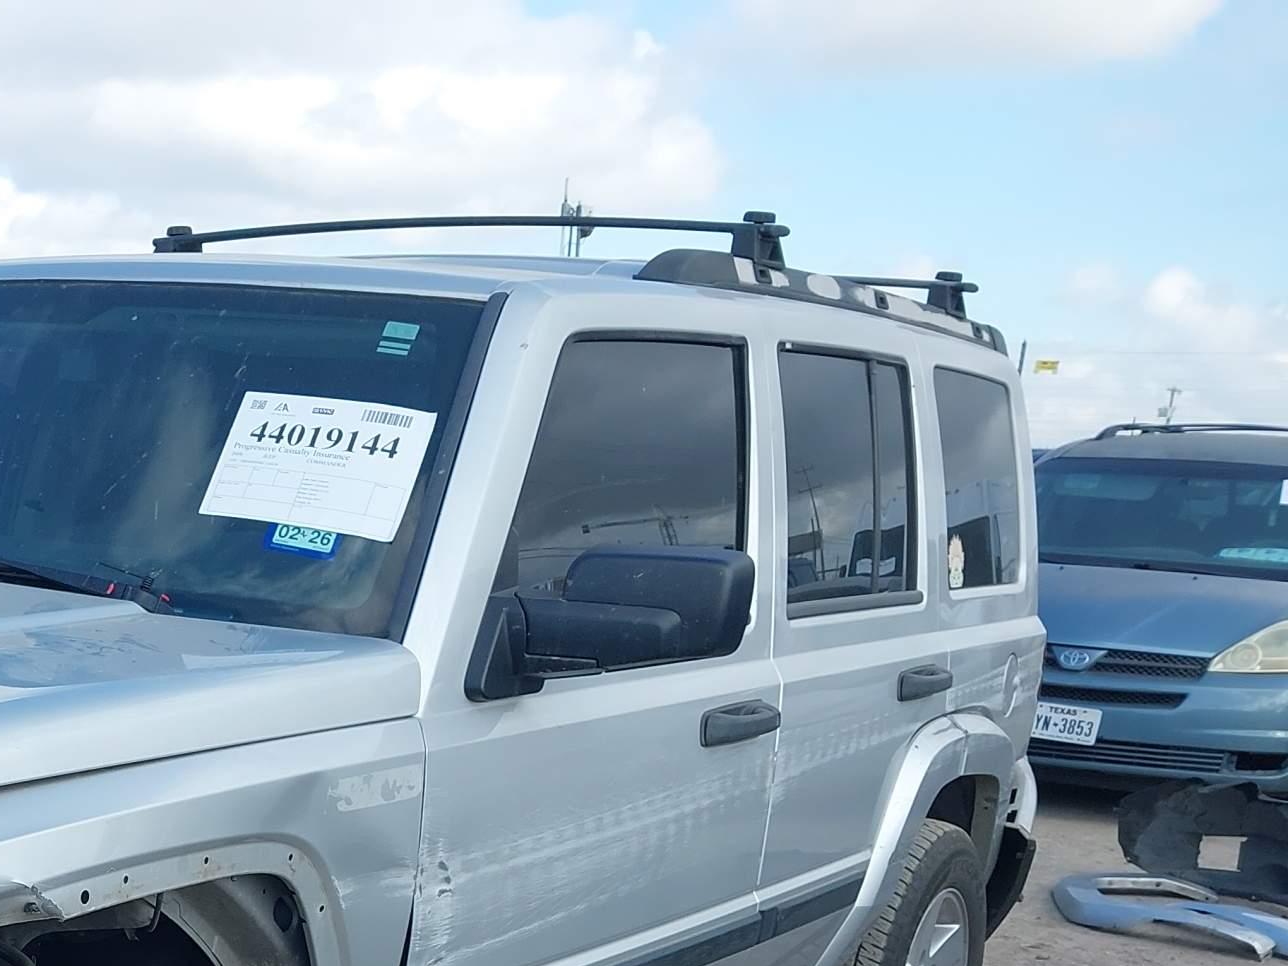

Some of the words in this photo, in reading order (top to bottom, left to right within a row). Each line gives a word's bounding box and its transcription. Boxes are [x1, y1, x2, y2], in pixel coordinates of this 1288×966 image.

[250, 421, 400, 459] 44019144
[233, 442, 277, 453] Progressive
[278, 446, 310, 458] Casualty
[313, 449, 352, 461] Insurance
[278, 524, 301, 541] 02
[309, 529, 332, 546] 26
[1049, 706, 1078, 716] TEXAS
